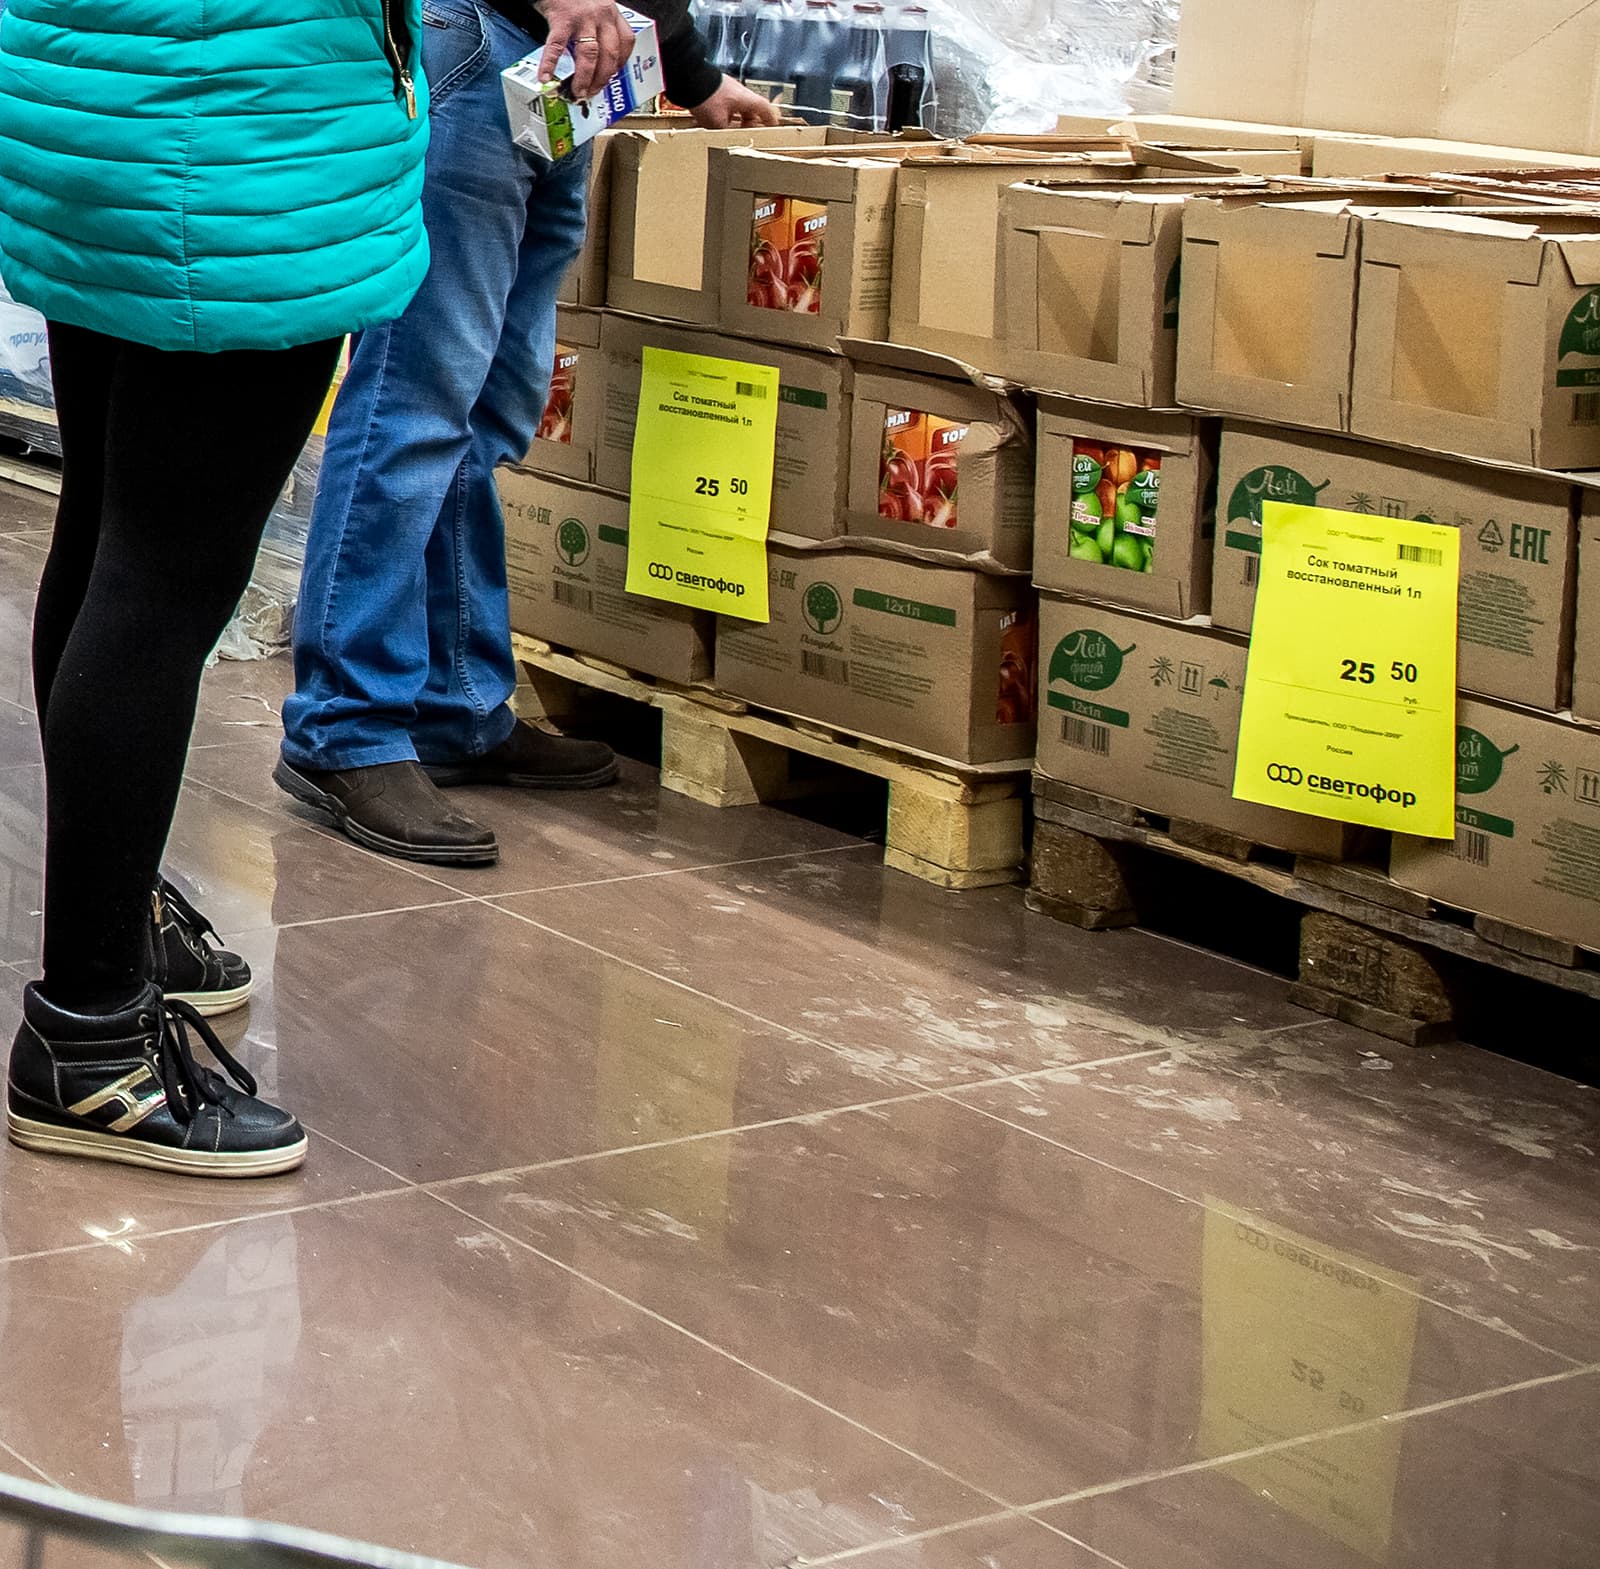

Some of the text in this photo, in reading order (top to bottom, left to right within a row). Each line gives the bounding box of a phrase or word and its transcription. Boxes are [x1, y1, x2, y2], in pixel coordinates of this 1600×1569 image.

[755, 203, 776, 219] МАТ
[804, 215, 827, 232] ТОМ
[559, 354, 579, 369] ТОМ
[673, 391, 737, 410] Сок томатный
[659, 404, 752, 426] восстановленный 1л
[886, 412, 911, 428] МАТ
[942, 427, 969, 444] ТОМ
[695, 477, 748, 497] 25 50
[1510, 523, 1552, 565] EAC
[1307, 555, 1398, 579] Сок томатный
[676, 569, 745, 596] светофор
[1287, 569, 1422, 600] восстановленный 1л
[1340, 659, 1418, 684] 25 50
[1326, 744, 1353, 756] Россия
[1458, 734, 1482, 758] ей
[1307, 772, 1417, 808] светофор
